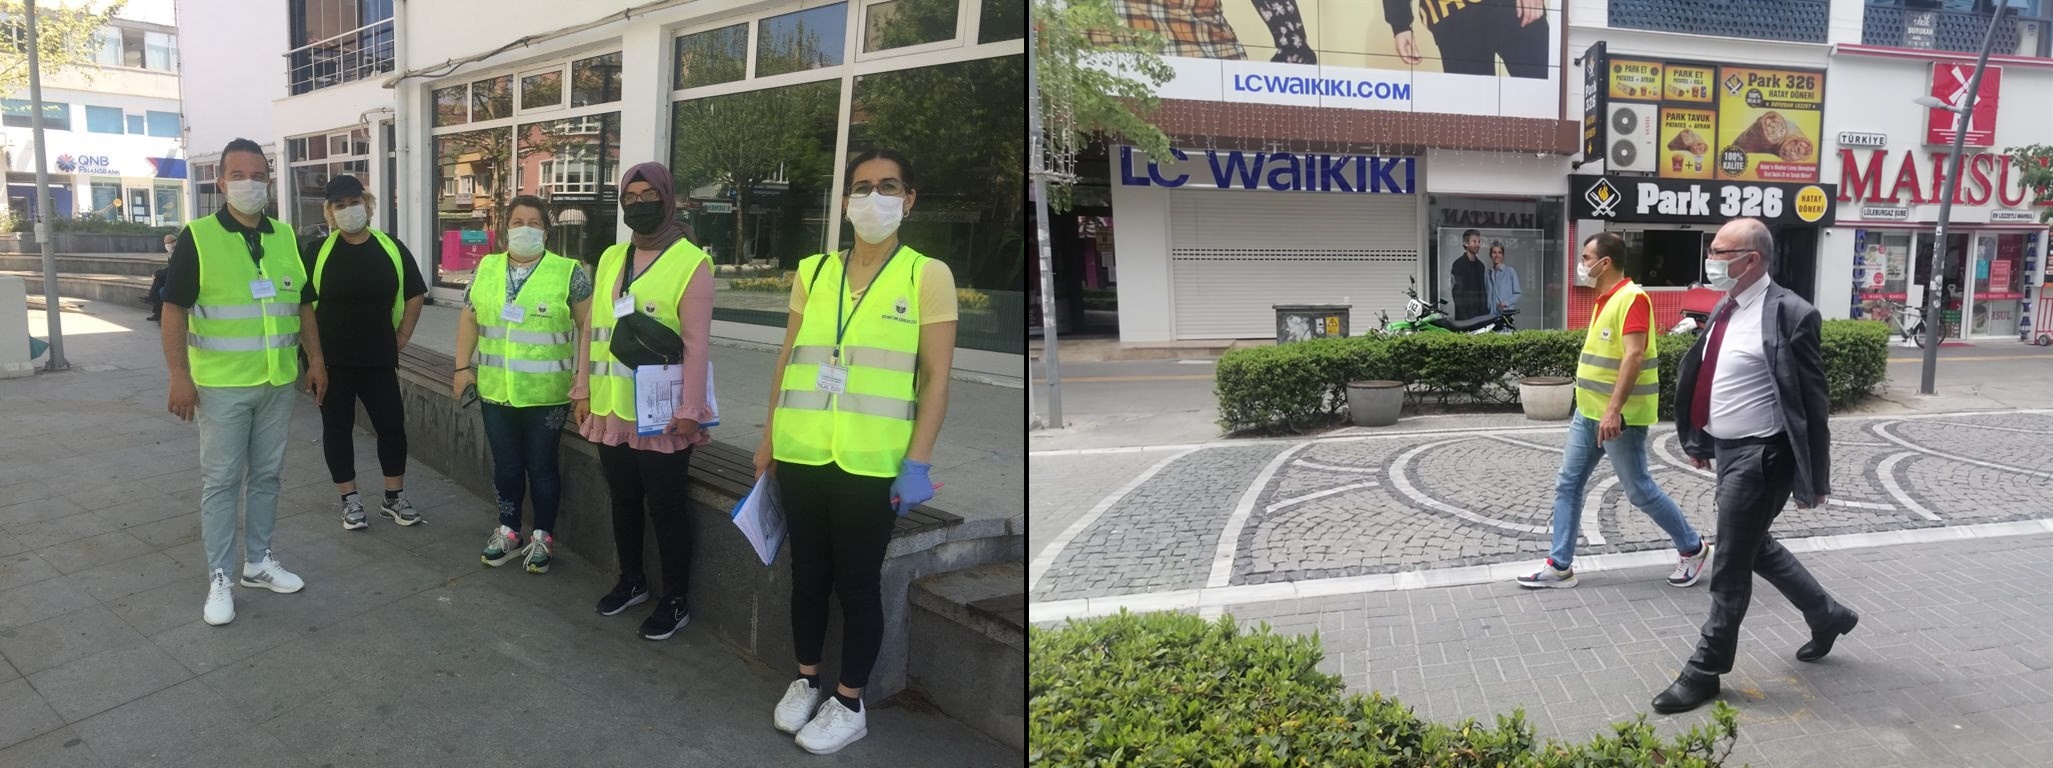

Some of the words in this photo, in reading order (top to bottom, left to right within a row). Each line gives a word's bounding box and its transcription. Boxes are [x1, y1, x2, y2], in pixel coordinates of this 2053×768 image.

[1624, 65, 1639, 74] PARK
[1640, 66, 1647, 74] ET
[1673, 69, 1693, 78] PARK
[1695, 70, 1704, 79] ET
[1747, 72, 1781, 88] Park
[1786, 75, 1815, 90] 326
[1768, 90, 1788, 99] HATAY
[1666, 112, 1686, 121] PARK
[1687, 113, 1711, 122] TAVUK
[1841, 133, 1885, 145] TÜRKİYE
[78, 155, 110, 167] QNB
[1724, 152, 1744, 161] 100%
[1120, 146, 1190, 188] LC
[1636, 182, 1711, 216] Park
[1720, 185, 1783, 218] 326
[1801, 194, 1822, 203] HATAY
[1798, 203, 1824, 213] DÖNERİ
[1894, 209, 1907, 218] ŞUBE
